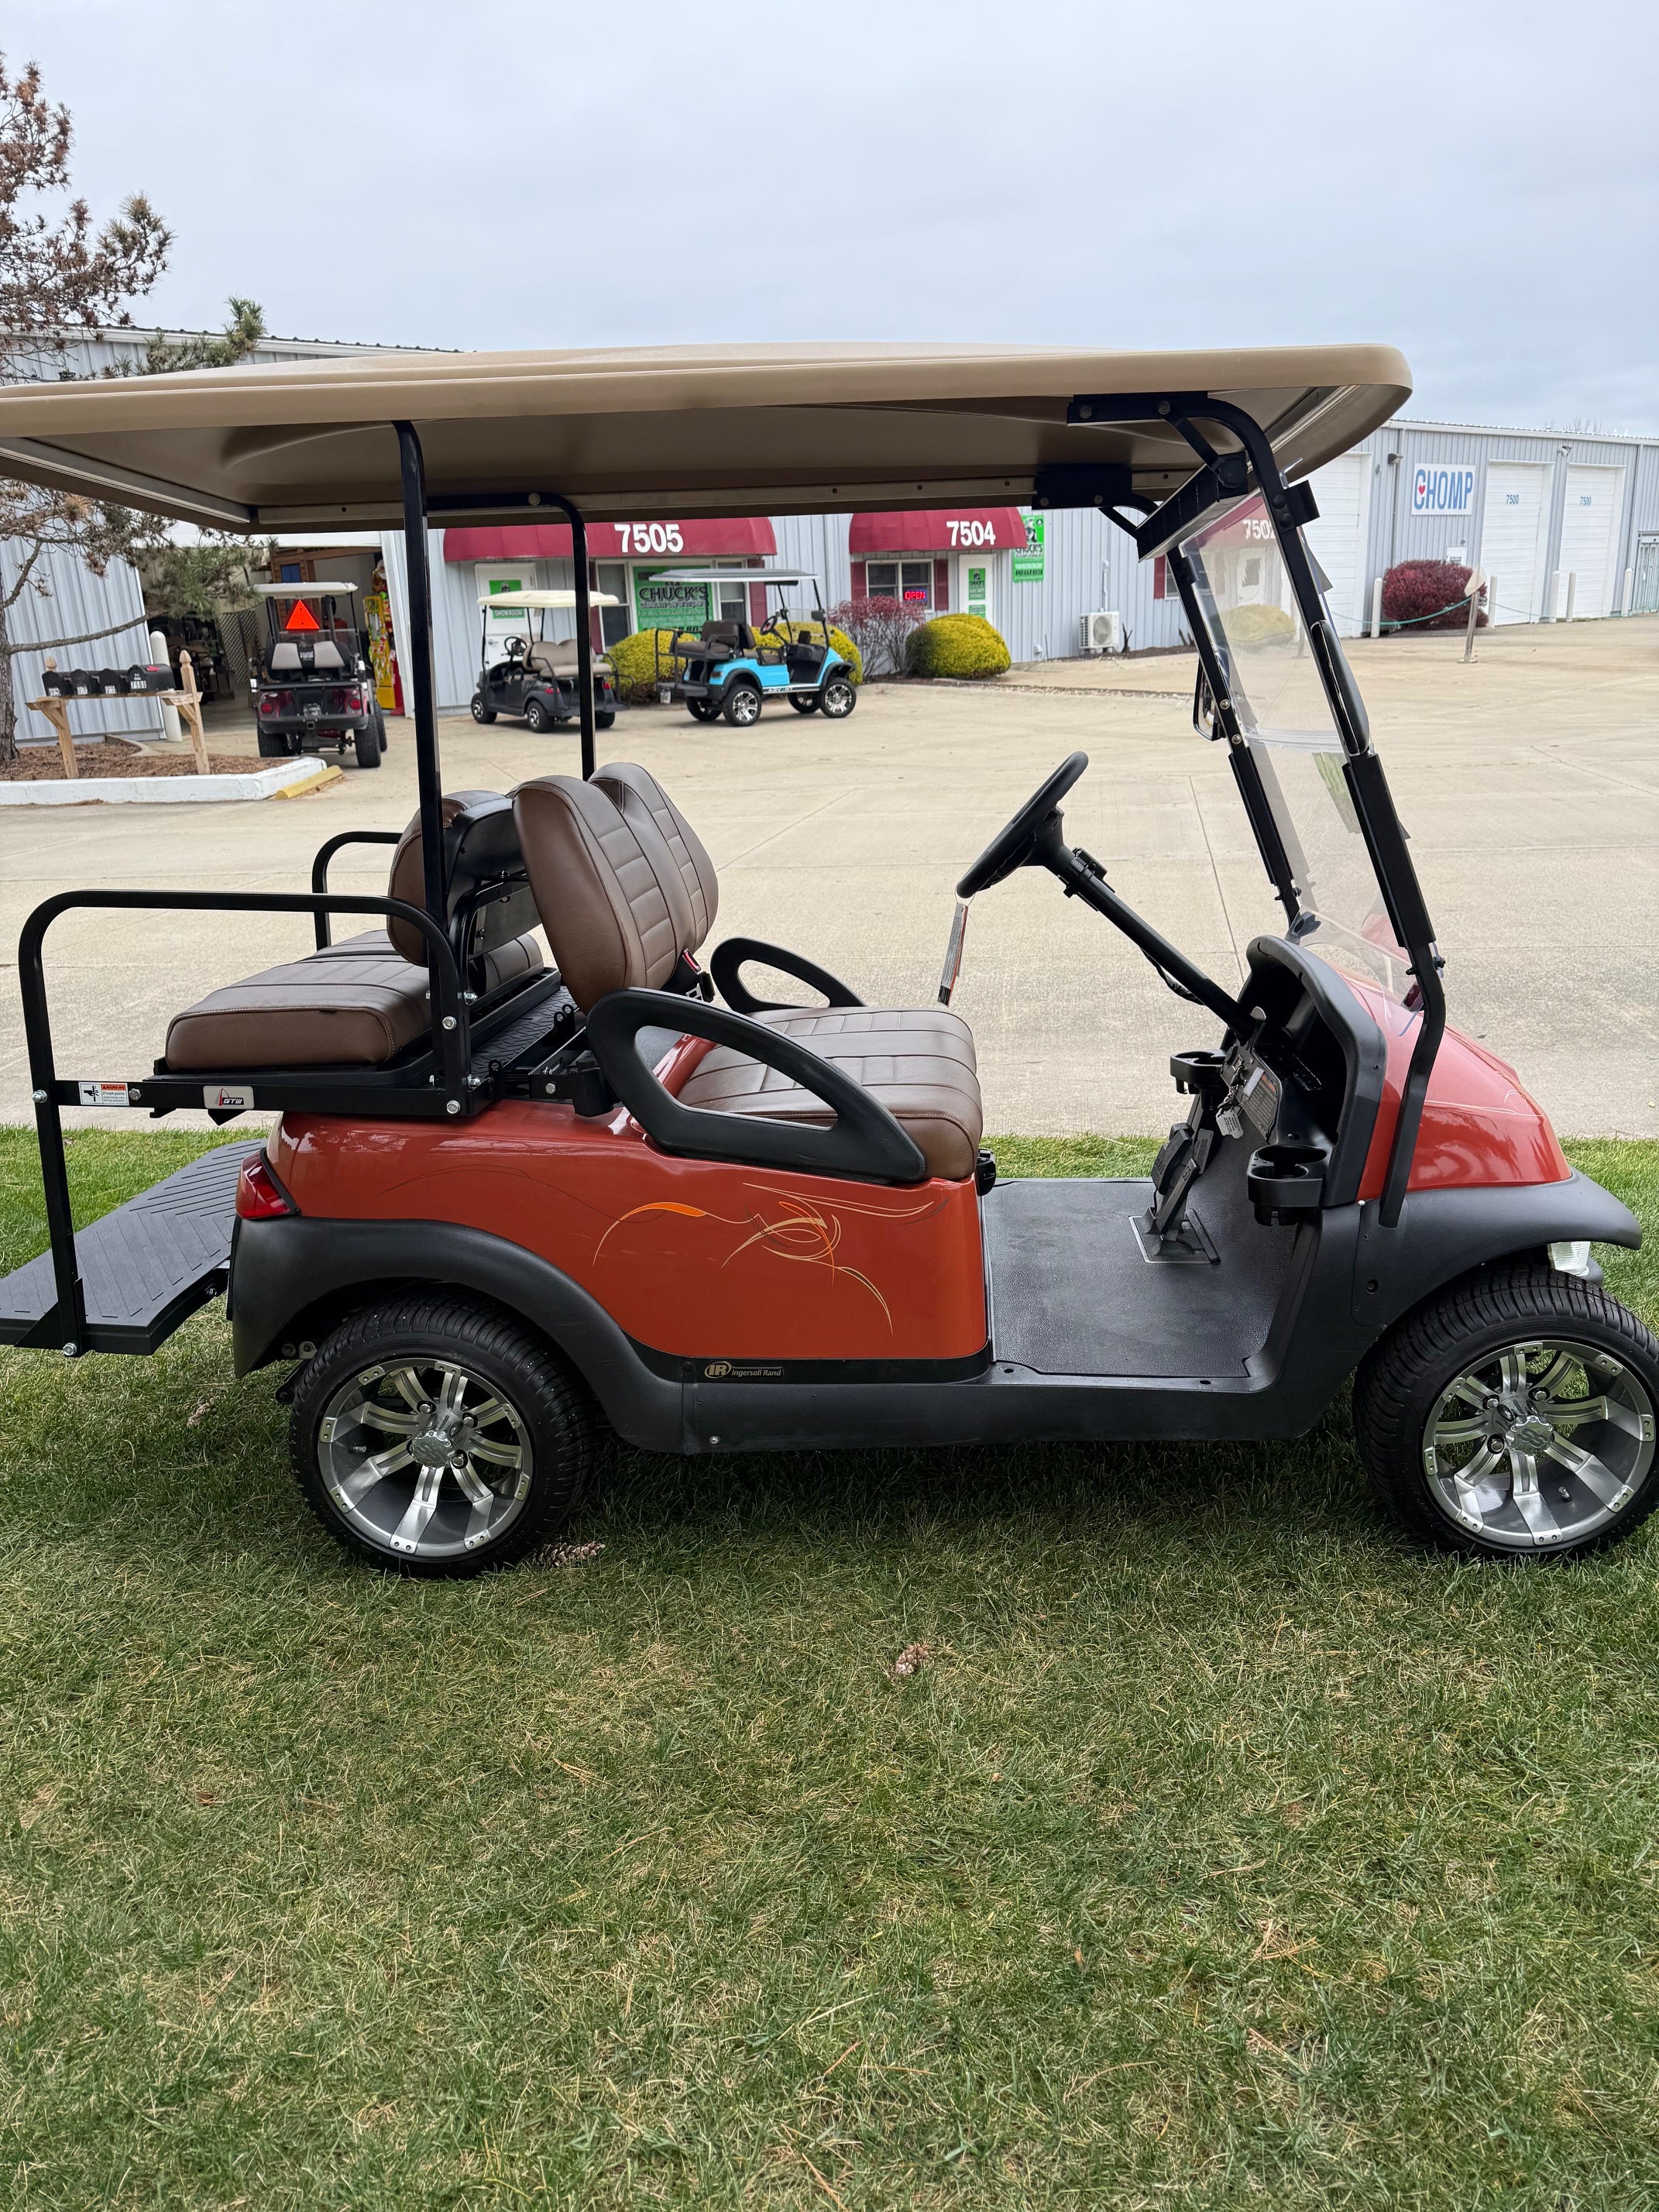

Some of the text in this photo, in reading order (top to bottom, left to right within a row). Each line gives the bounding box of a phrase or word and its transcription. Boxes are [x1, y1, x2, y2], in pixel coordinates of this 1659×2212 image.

[1413, 469, 1473, 510] CHOMP
[1506, 494, 1520, 505] 7500
[1580, 496, 1592, 507] 7500
[614, 523, 684, 554] 7505
[946, 520, 996, 546] 7504
[639, 586, 708, 601] CHUCK'S
[905, 591, 926, 600] OPEN
[709, 1364, 726, 1376] IR
[731, 1369, 761, 1377] Ingersoll
